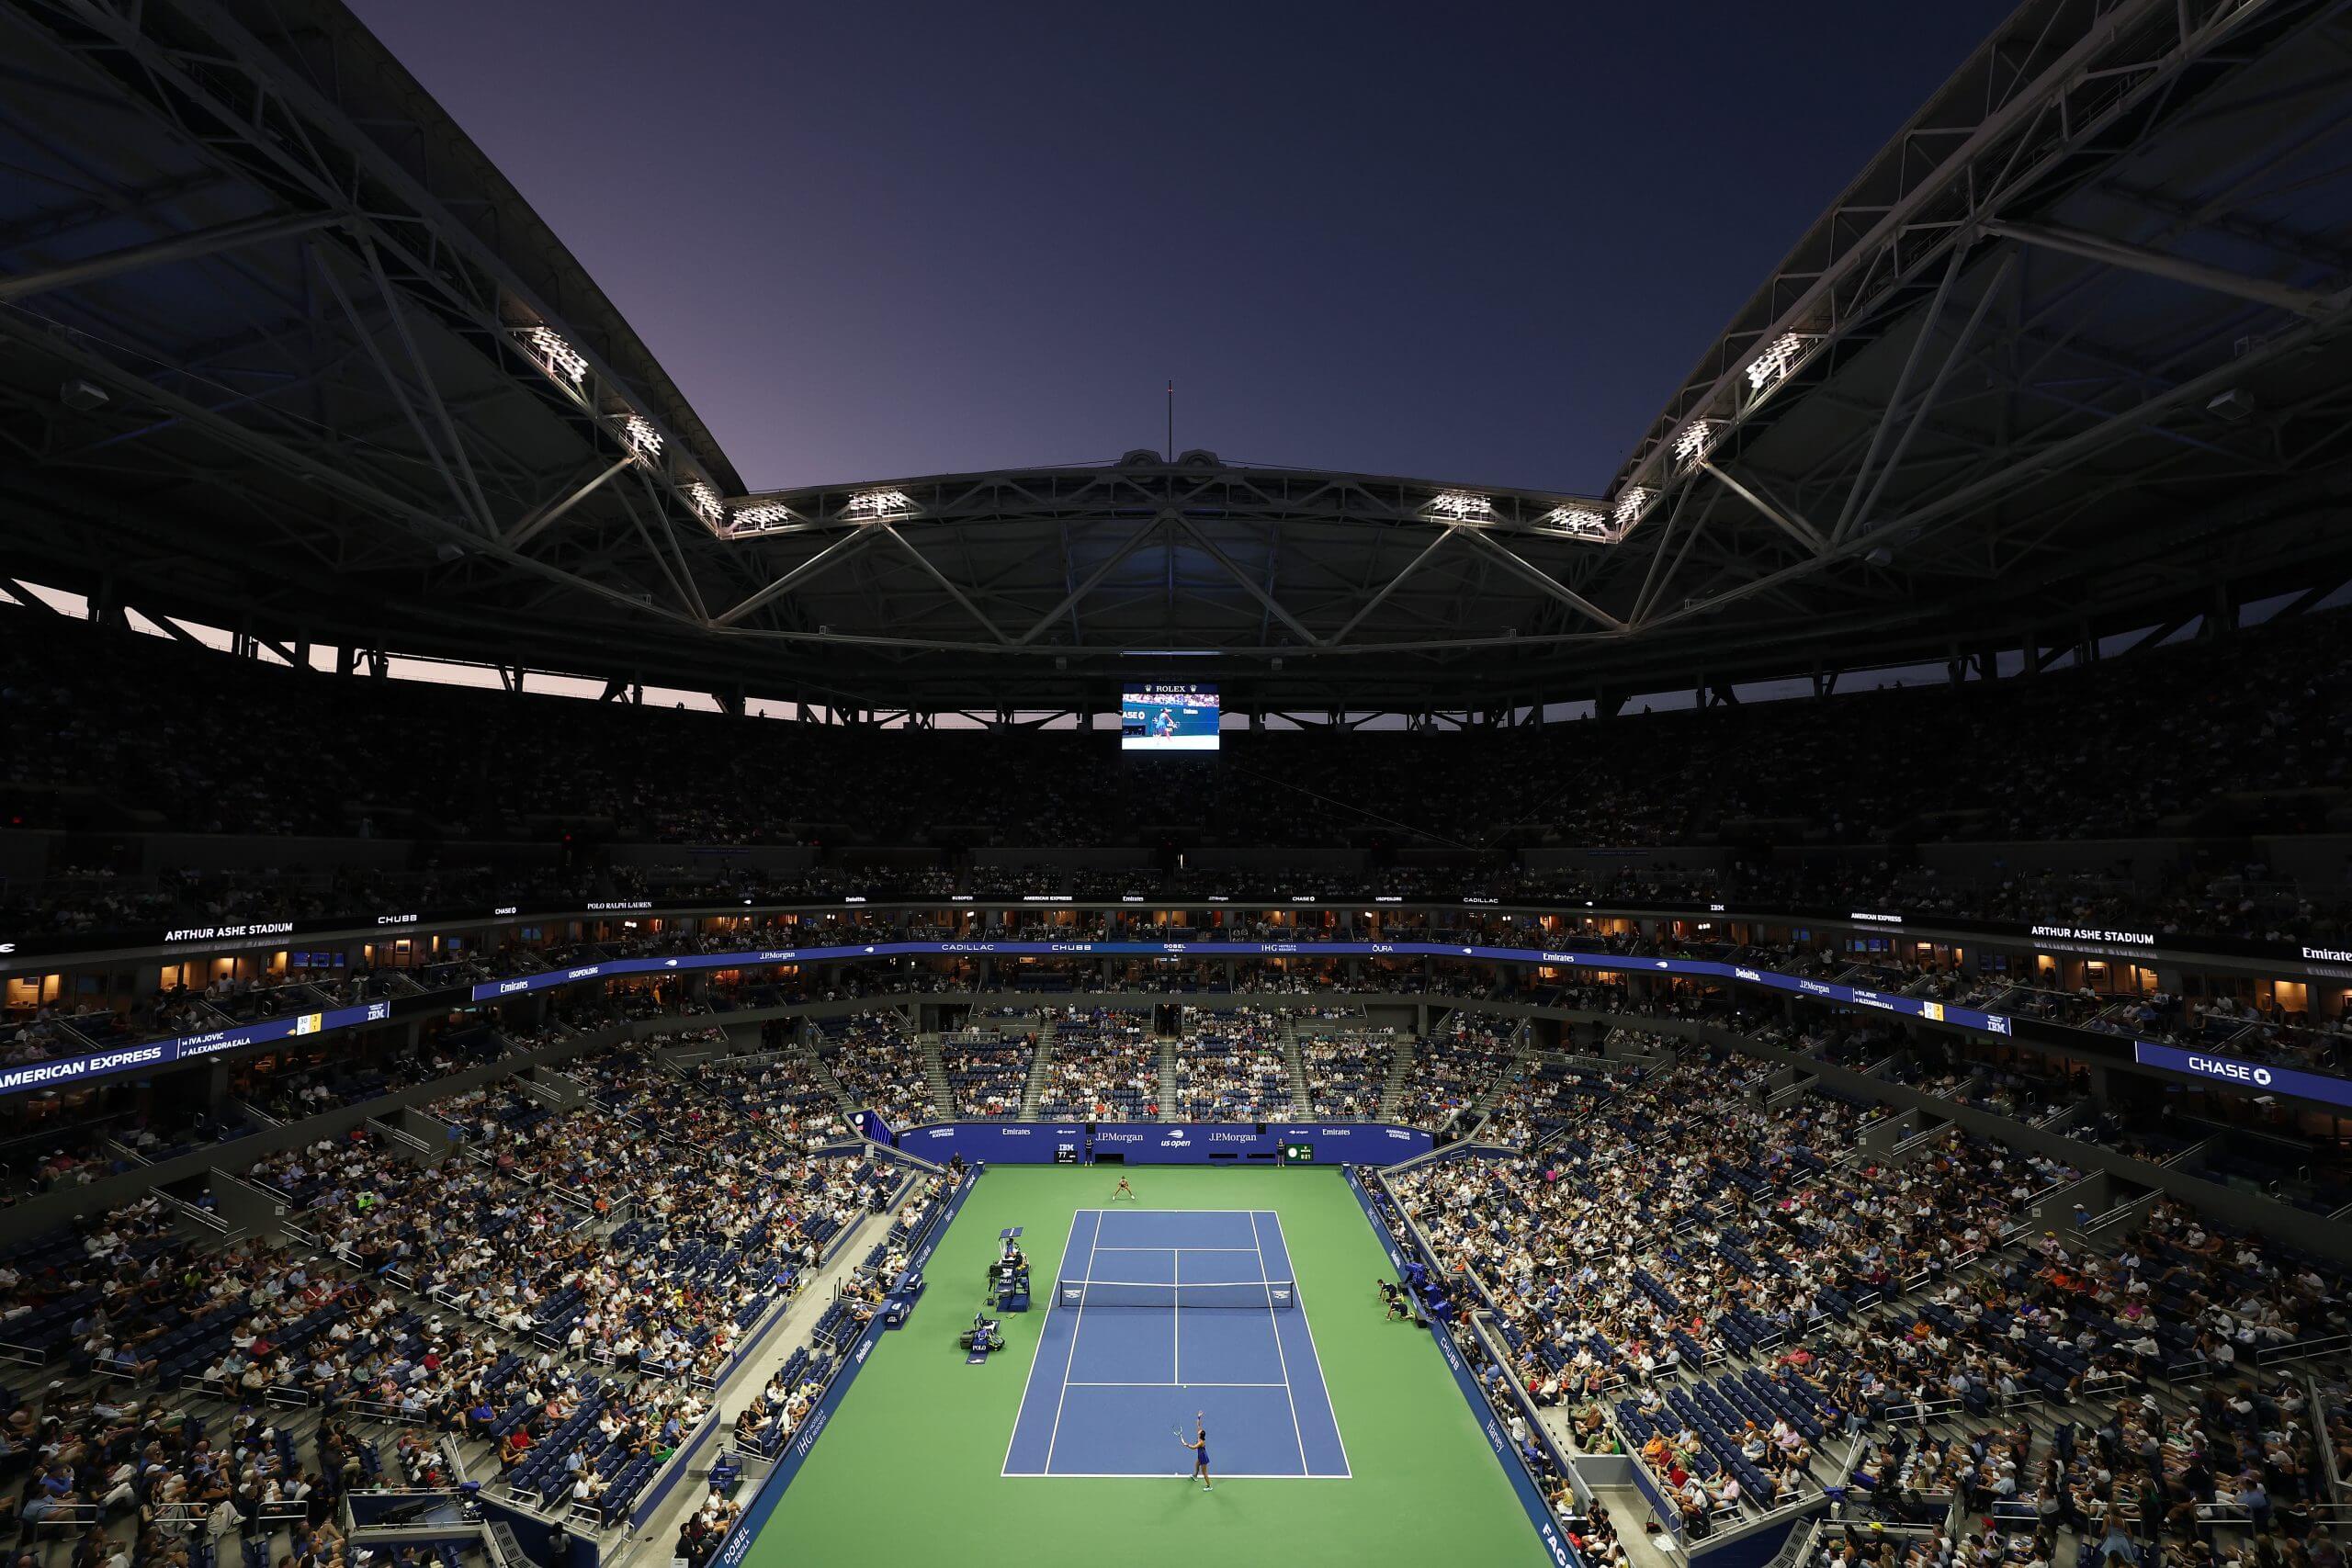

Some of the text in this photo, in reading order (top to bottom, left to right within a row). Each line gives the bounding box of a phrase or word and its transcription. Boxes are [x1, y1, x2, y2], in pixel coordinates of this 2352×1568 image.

[494, 907, 512, 915] CHASE
[1850, 912, 1902, 923] AMERICAN EXPRESS
[378, 914, 417, 924] CHUBB
[164, 922, 293, 941] ARTHUR ASHE STADIUM
[2031, 926, 2154, 944] ARTHUR ASHE STADIUM
[760, 952, 796, 961] J.P.Morgan
[1543, 953, 1575, 963] Emirates
[568, 966, 599, 979] USOPEN.ORG
[1736, 967, 1761, 981] Deloitte.
[500, 980, 528, 993] Emirates
[1799, 979, 1829, 995] J.P.Morgan
[368, 1010, 385, 1021] IBM
[1987, 1021, 2007, 1033] IBM
[188, 1037, 201, 1045] IVA
[202, 1032, 224, 1043] JOVIC
[187, 1041, 232, 1055] ALEXANDRA
[232, 1037, 251, 1047] EALA
[90, 1047, 162, 1071] EXPRESS
[2188, 1056, 2251, 1080] CHASE
[1095, 1132, 1143, 1144] J.P.Morgan
[1170, 1140, 1191, 1148] open
[1208, 1132, 1257, 1144] J.P.Morgan
[915, 1245, 932, 1269] CHUBB
[1440, 1337, 1460, 1371] CHUBB
[1487, 1418, 1505, 1453] Harvey
[797, 1430, 813, 1456] IHG
[723, 1527, 750, 1565] DOBEL
[732, 1539, 751, 1565] TEQUILA
